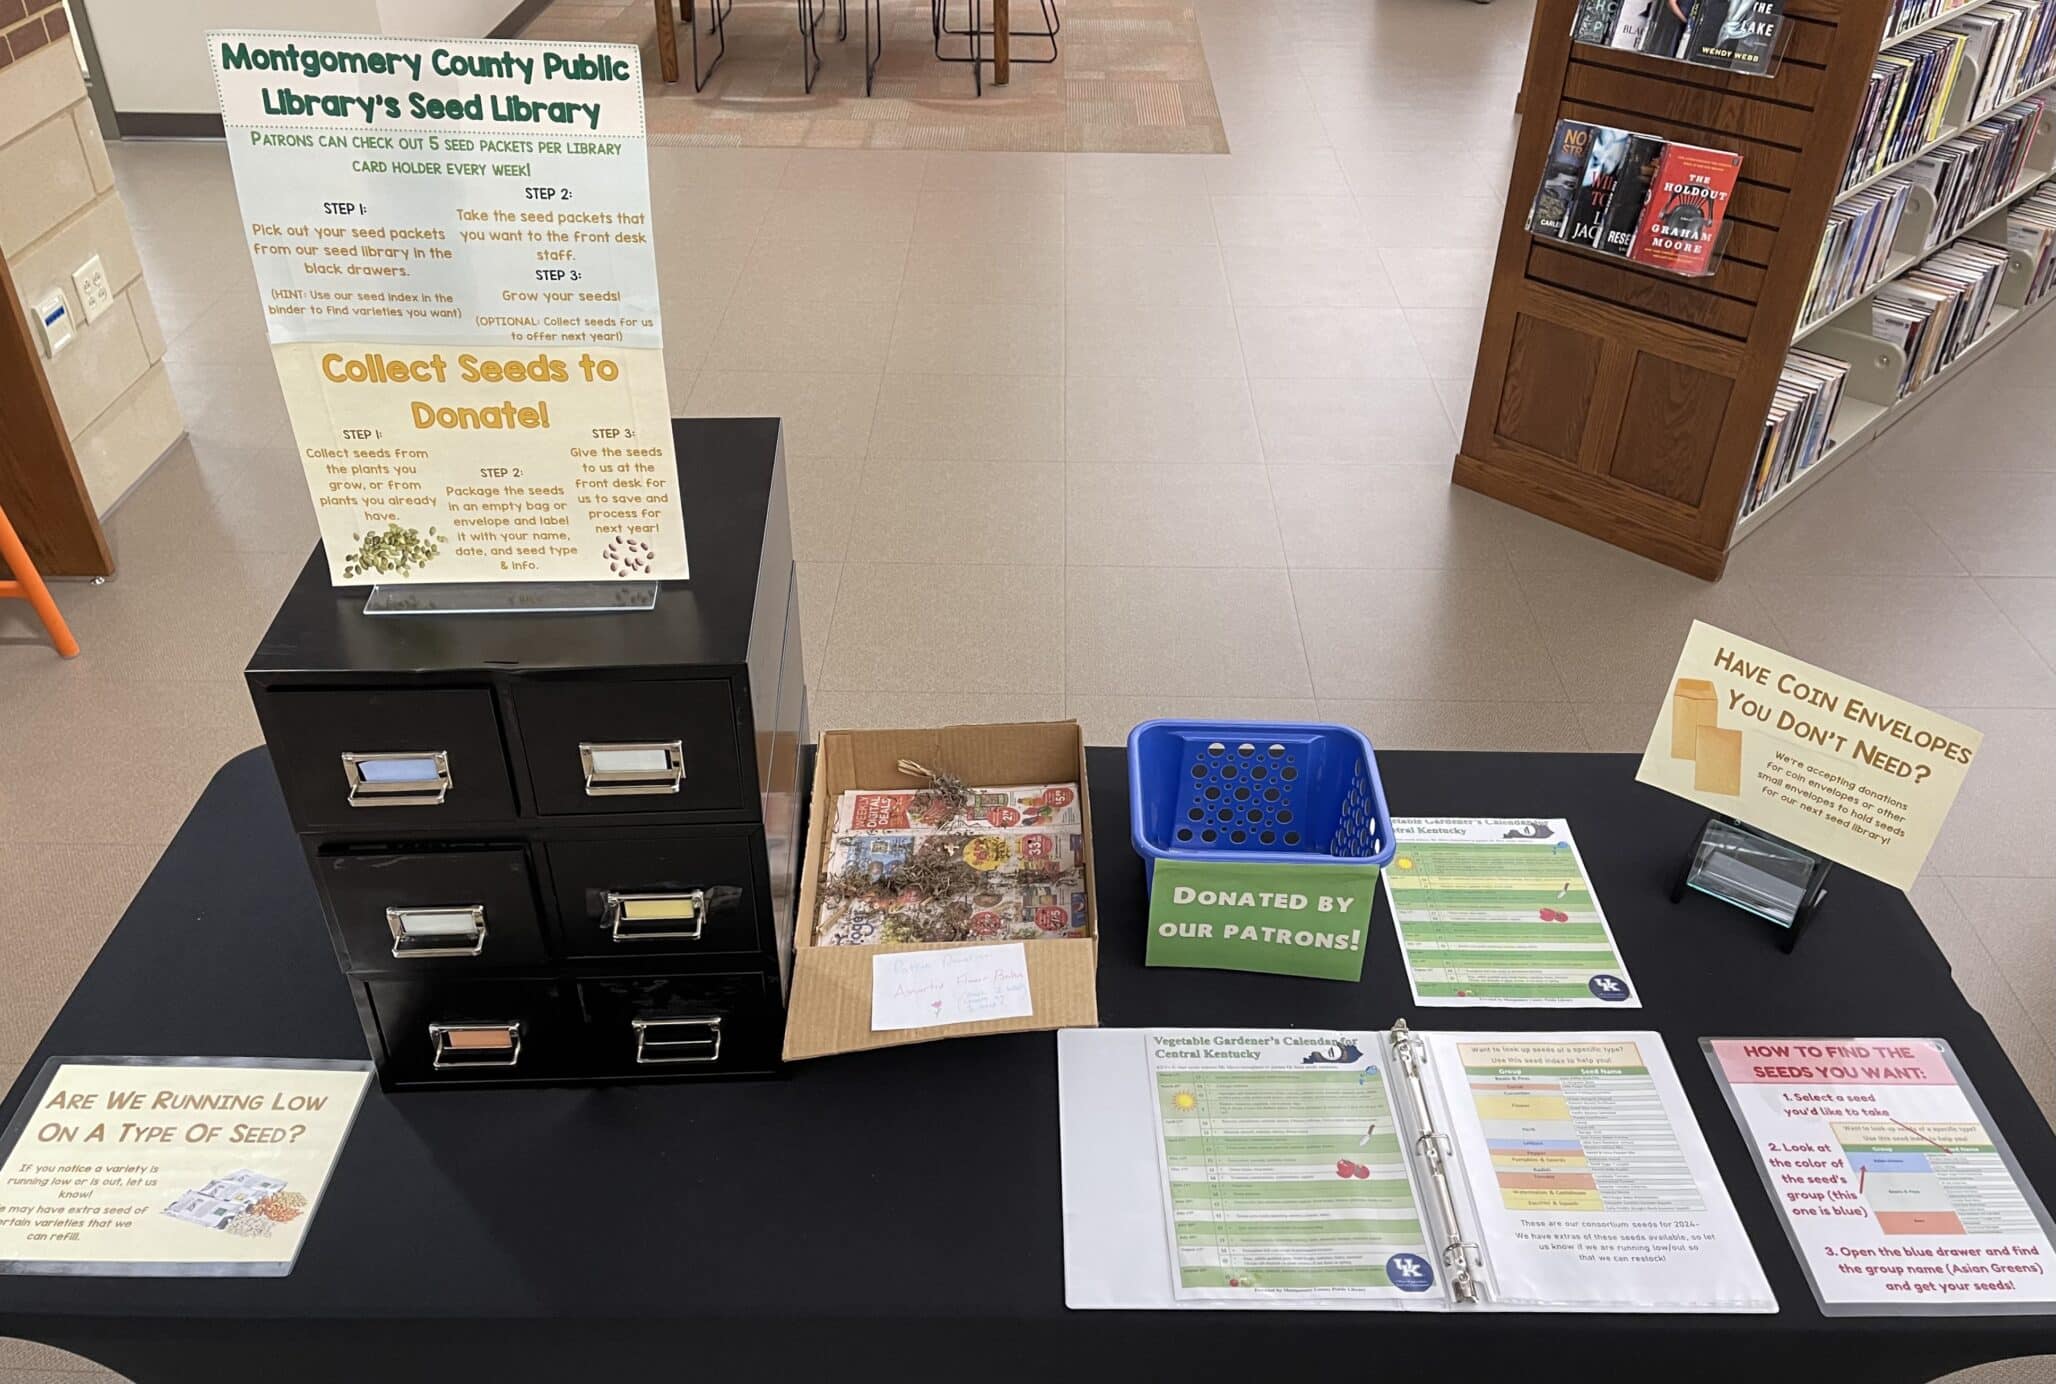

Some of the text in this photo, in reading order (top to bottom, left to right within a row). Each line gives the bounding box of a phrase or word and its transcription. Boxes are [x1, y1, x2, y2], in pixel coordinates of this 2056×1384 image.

[1702, 46, 1758, 62] WENDY WEBB
[221, 43, 630, 84] Montgomery County Public
[262, 88, 599, 128] Library's Seed Library
[251, 131, 621, 156] PATRONS CAN CHECK OUT 5 SEED PACKETS PER LIBRARY
[1564, 129, 1588, 146] NO
[352, 161, 531, 177] CARD HOLDER EVERY WEEK!
[1689, 174, 1711, 183] THE
[525, 187, 573, 200] STEP 2:
[1664, 182, 1727, 200] HOLDOUT
[323, 202, 368, 215] STEP 1:
[457, 209, 645, 225] Take the seed packets that
[252, 224, 445, 241] Pick out your seed packets
[460, 230, 647, 244] you want to the front desk
[1652, 224, 1712, 242] GRAHAM
[254, 243, 452, 260] from our seed library in the
[1652, 237, 1702, 254] MOORE
[536, 249, 576, 261] staff.
[304, 262, 410, 277] black drawers.
[536, 270, 582, 281] STEP 3:
[322, 353, 619, 383] Collect Seeds to
[411, 402, 550, 429] Donate!
[306, 448, 428, 459] Collect seeds from
[570, 447, 663, 458] Give the seeds
[446, 486, 564, 498] Package the seeds
[1714, 647, 1973, 765] HAVE COIN ENVELOPES
[1728, 688, 1932, 785] YOU DON'T NEED?
[1776, 751, 1908, 811] We're accepting donations
[1767, 761, 1906, 823] for coin envelopes or other
[867, 796, 880, 828] DIGITAL
[878, 798, 891, 824] DEALS
[1758, 770, 1906, 838] small envelopes to hold seeds
[1762, 786, 1891, 846] for our next seed library!
[1174, 887, 1355, 914] DONATED BY
[1158, 922, 1361, 951] OUR PATRONS!
[1153, 1036, 1211, 1048] Vegetable
[1213, 1036, 1281, 1046] Gardener's
[1284, 1036, 1336, 1047] Calendar
[1155, 1049, 1261, 1061] Central Kentucky
[1744, 1046, 1915, 1059] HOW TO FIND THE
[1753, 1066, 1927, 1080] SEEDS YOU WANT:
[46, 1091, 328, 1111] ARE WE RUNNING LOW
[38, 1123, 306, 1144] ON A TYPE OF SEED?
[19, 1164, 32, 1172] If
[36, 1166, 55, 1174] you
[58, 1164, 92, 1172] notice
[106, 1165, 146, 1174] variety
[7, 1178, 48, 1187] running
[103, 1178, 123, 1186] out,
[126, 1178, 141, 1186] let
[1826, 1246, 2039, 1258] 3. Open the blue drawer and find
